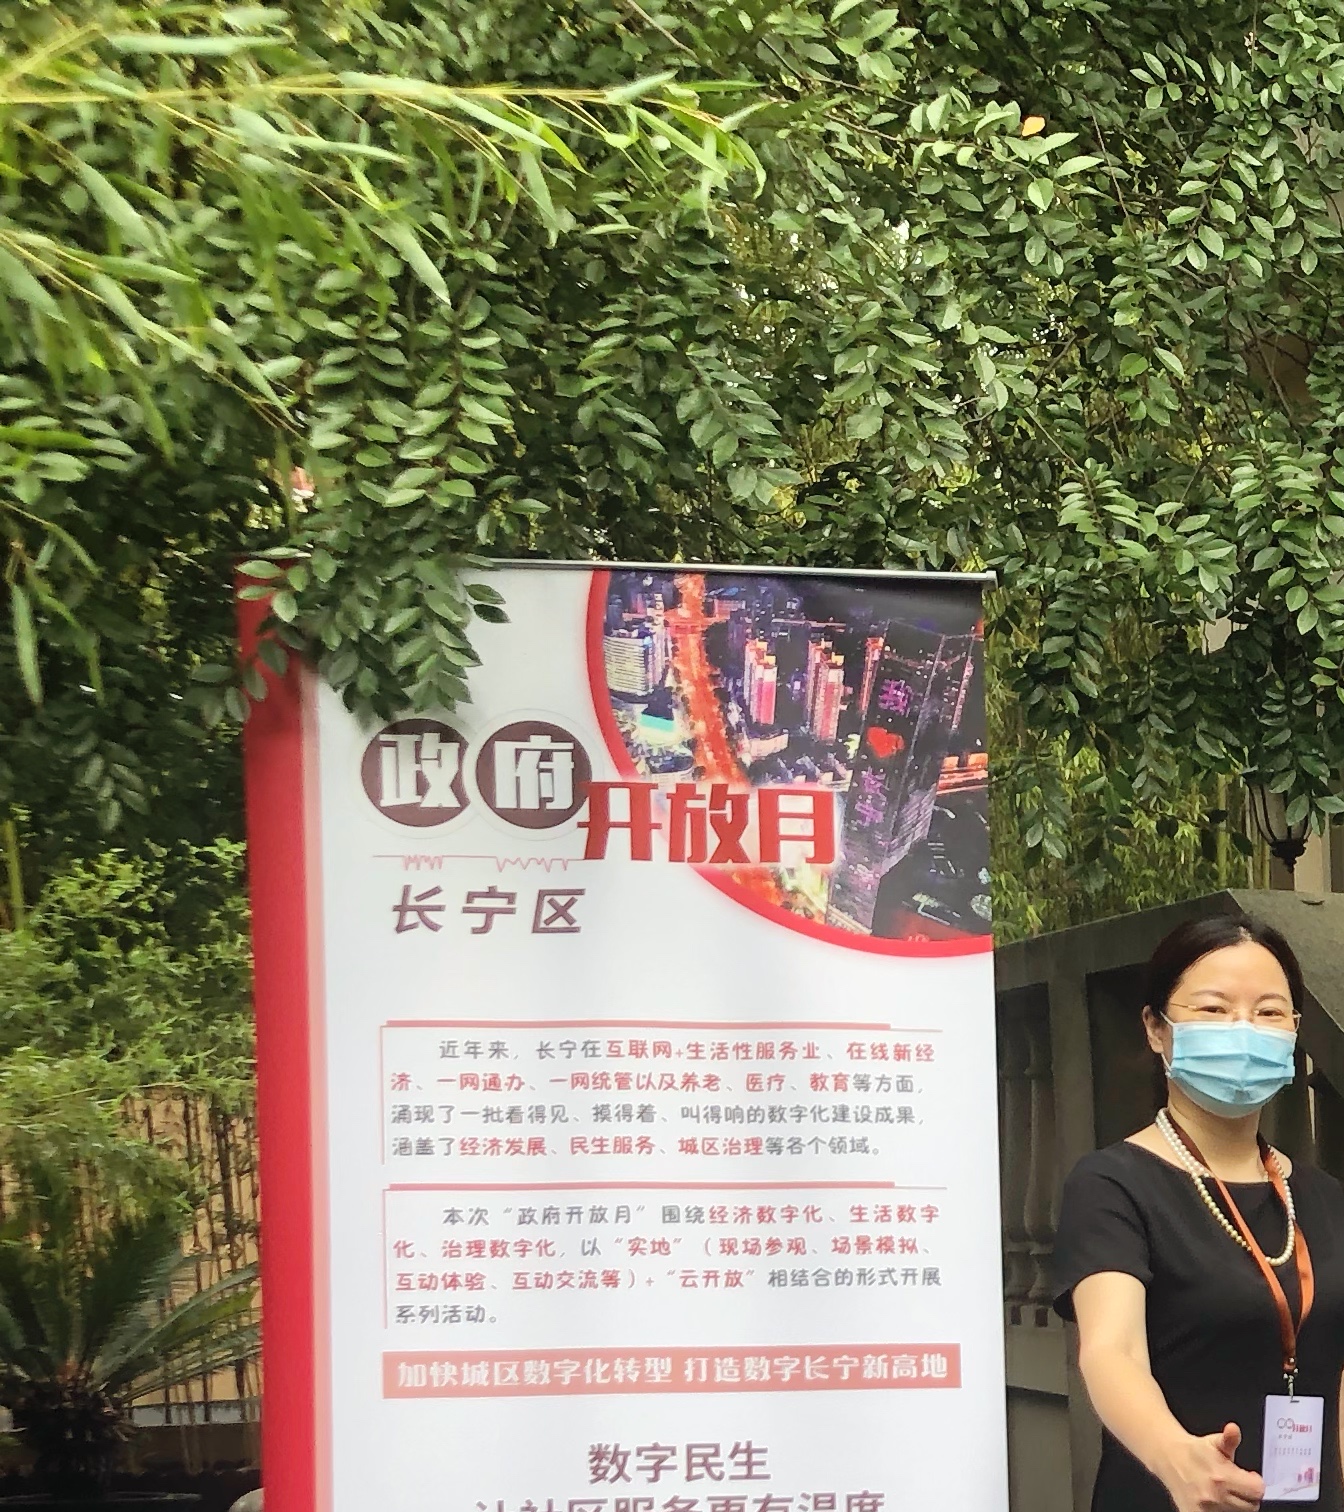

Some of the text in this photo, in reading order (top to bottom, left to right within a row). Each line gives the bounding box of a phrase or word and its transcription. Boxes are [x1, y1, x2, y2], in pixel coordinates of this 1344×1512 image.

[379, 732, 574, 811] 政府
[578, 780, 837, 864] 开放月
[392, 884, 587, 935] 长宁区
[395, 1303, 498, 1325] 系列活动。
[398, 1352, 949, 1389] 加快城区数字化转型 打造数字长宁新高地
[587, 1439, 772, 1485] 数字民生
